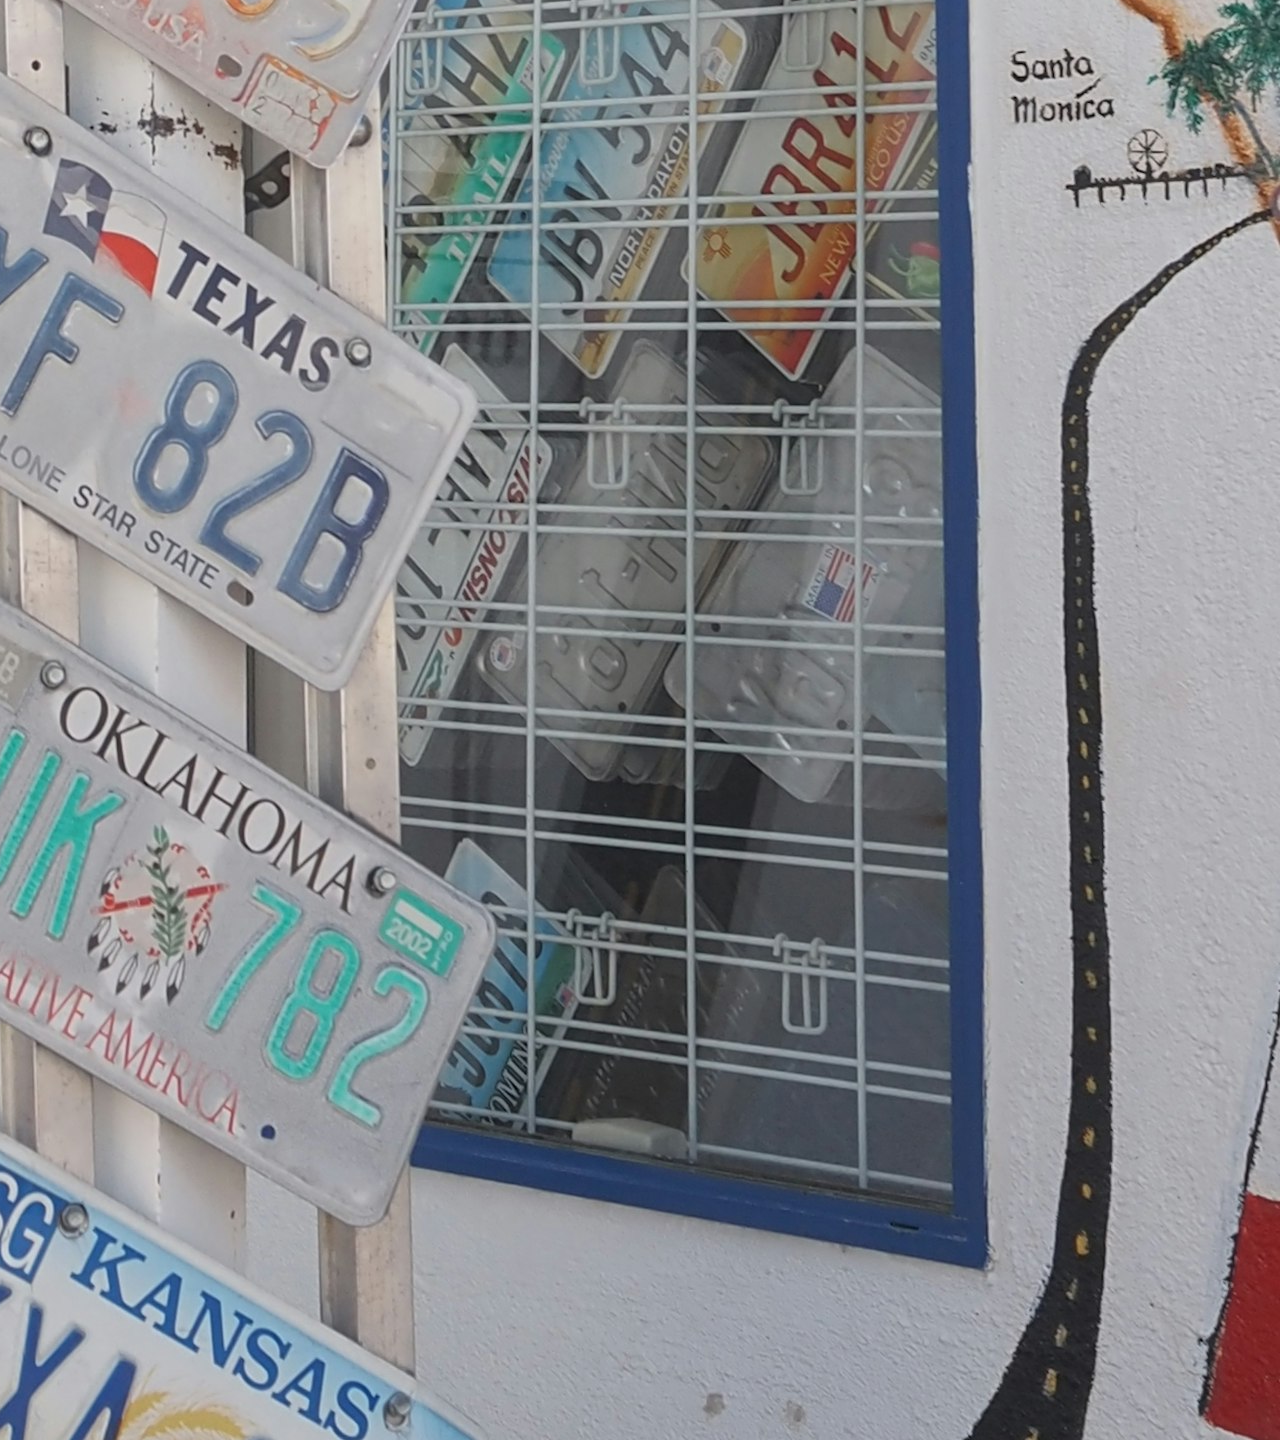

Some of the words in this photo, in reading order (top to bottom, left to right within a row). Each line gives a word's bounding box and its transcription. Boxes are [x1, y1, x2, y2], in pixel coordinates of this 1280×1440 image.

[1010, 49, 1095, 83] Santa
[1012, 76, 1115, 124] Monica
[162, 240, 341, 393] TEXAS
[72, 483, 139, 540] STAR
[142, 526, 221, 590] STATE
[134, 358, 392, 615] 82B
[59, 686, 359, 914] OKLAHOMA
[385, 917, 433, 960] 2002
[205, 881, 430, 1127] 782
[89, 1023, 244, 1137] AMERICA
